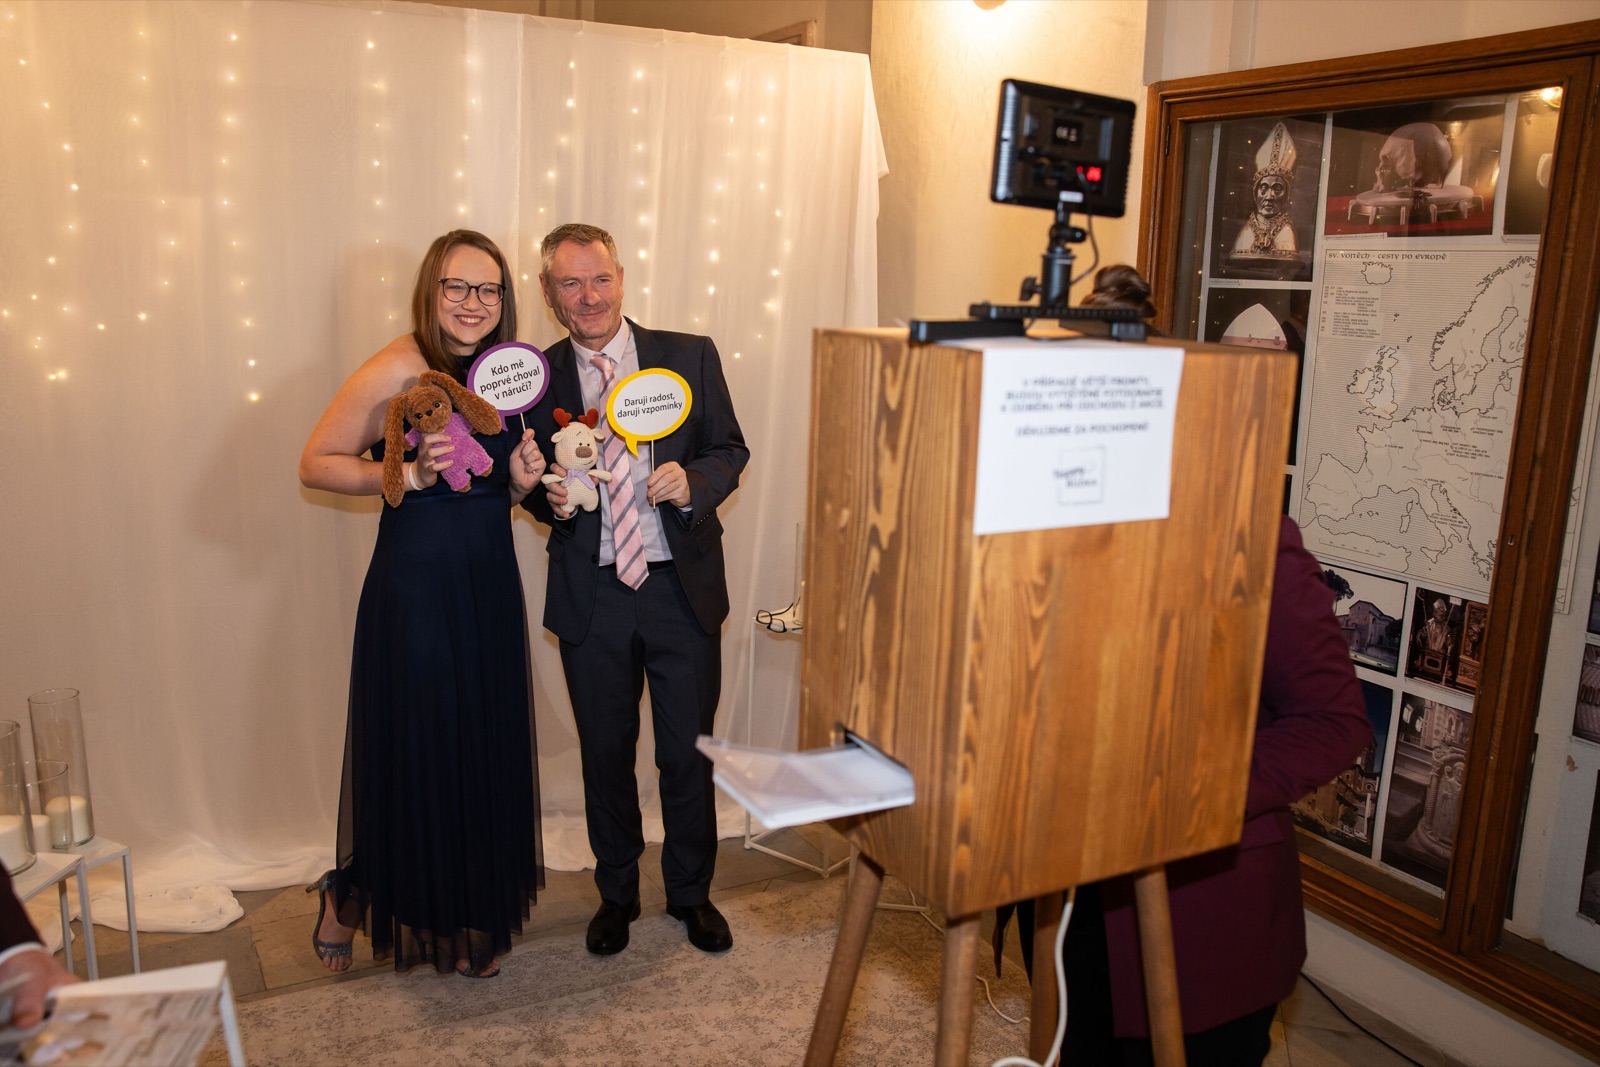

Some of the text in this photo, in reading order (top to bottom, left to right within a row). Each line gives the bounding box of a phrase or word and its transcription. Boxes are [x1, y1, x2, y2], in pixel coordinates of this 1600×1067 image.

[490, 359, 525, 376] Kdo mě
[480, 366, 541, 394] poprvé choval
[502, 381, 532, 398] náručí?
[624, 392, 676, 407] Daruji radost,
[617, 401, 683, 418] daruji vzpomínky
